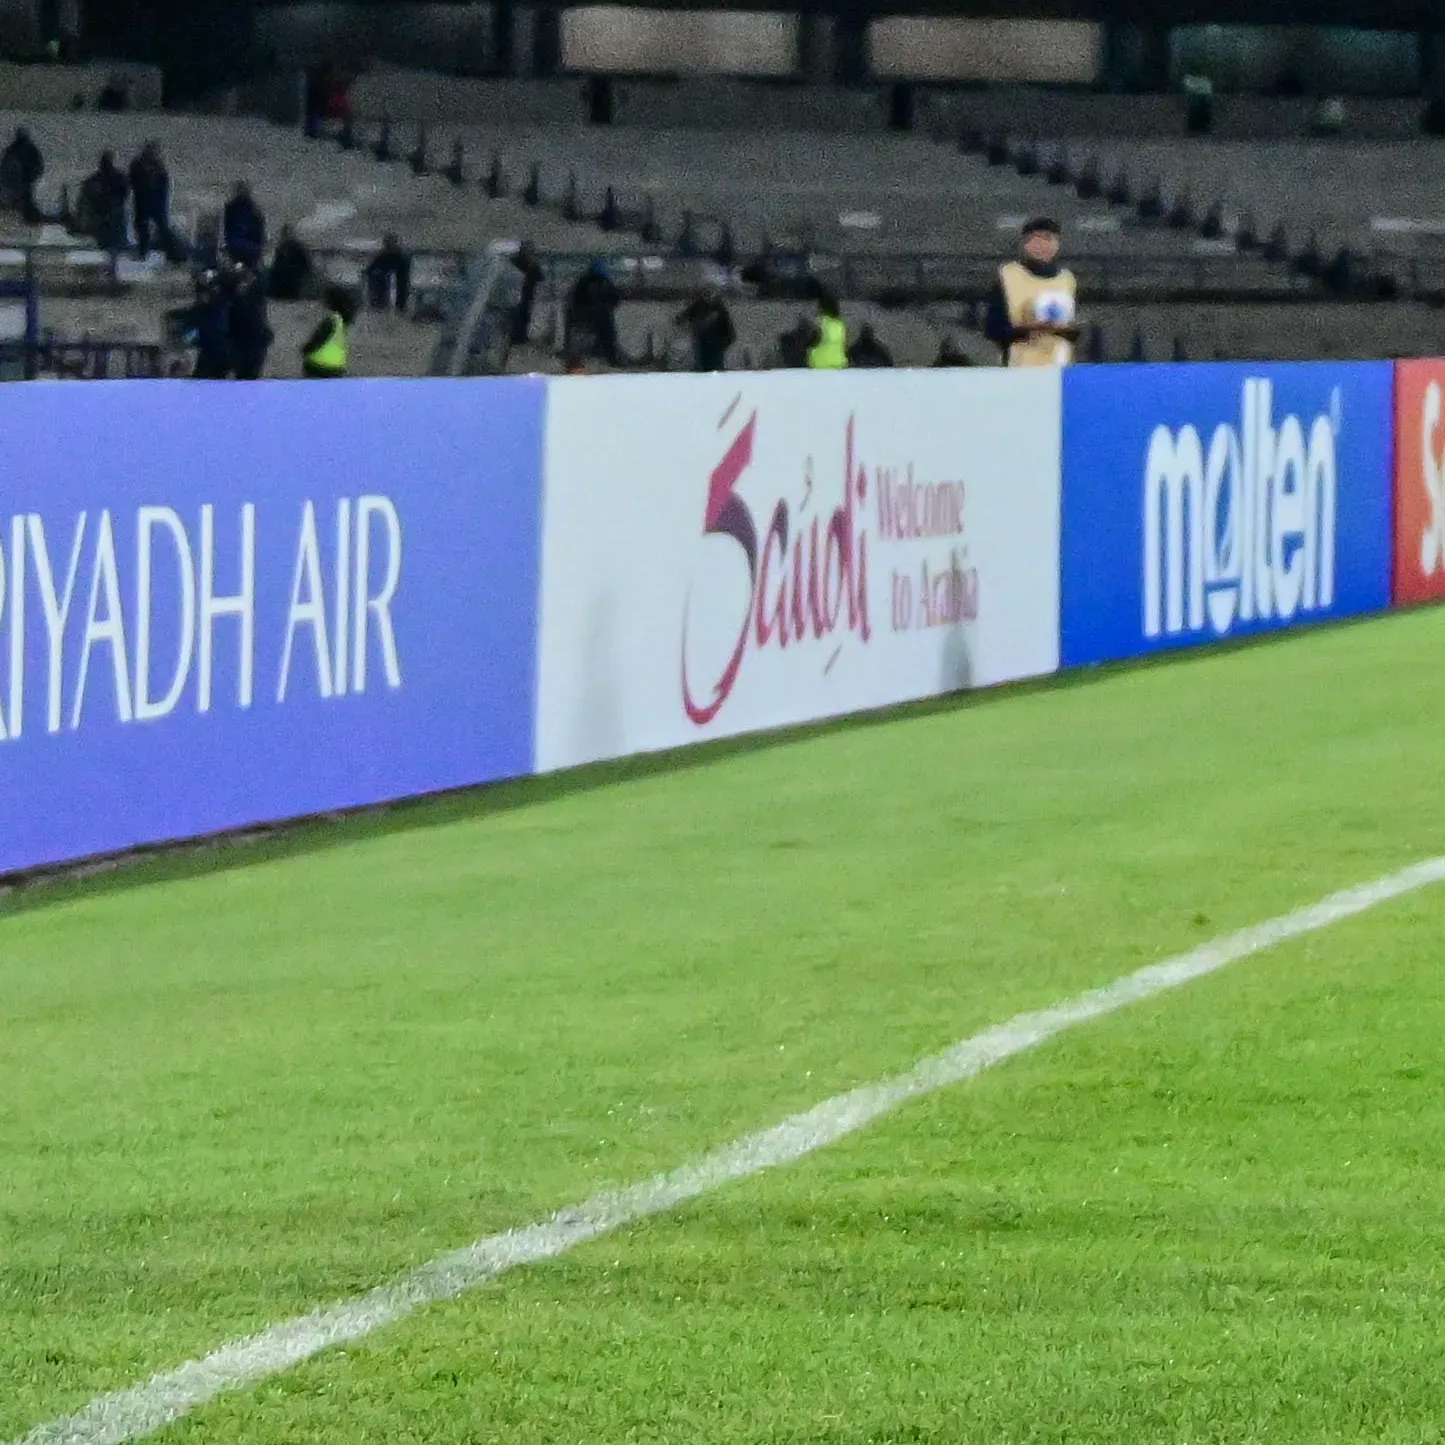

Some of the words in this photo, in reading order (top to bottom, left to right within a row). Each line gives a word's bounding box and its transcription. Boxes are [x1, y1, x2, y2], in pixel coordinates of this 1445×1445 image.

[0, 502, 256, 740] IYADH
[276, 494, 402, 703] AIR
[680, 402, 872, 726] Saudi
[876, 459, 965, 541] Welcome
[892, 566, 912, 633] to
[917, 543, 979, 628] Arabia
[1143, 377, 1338, 640] molten
